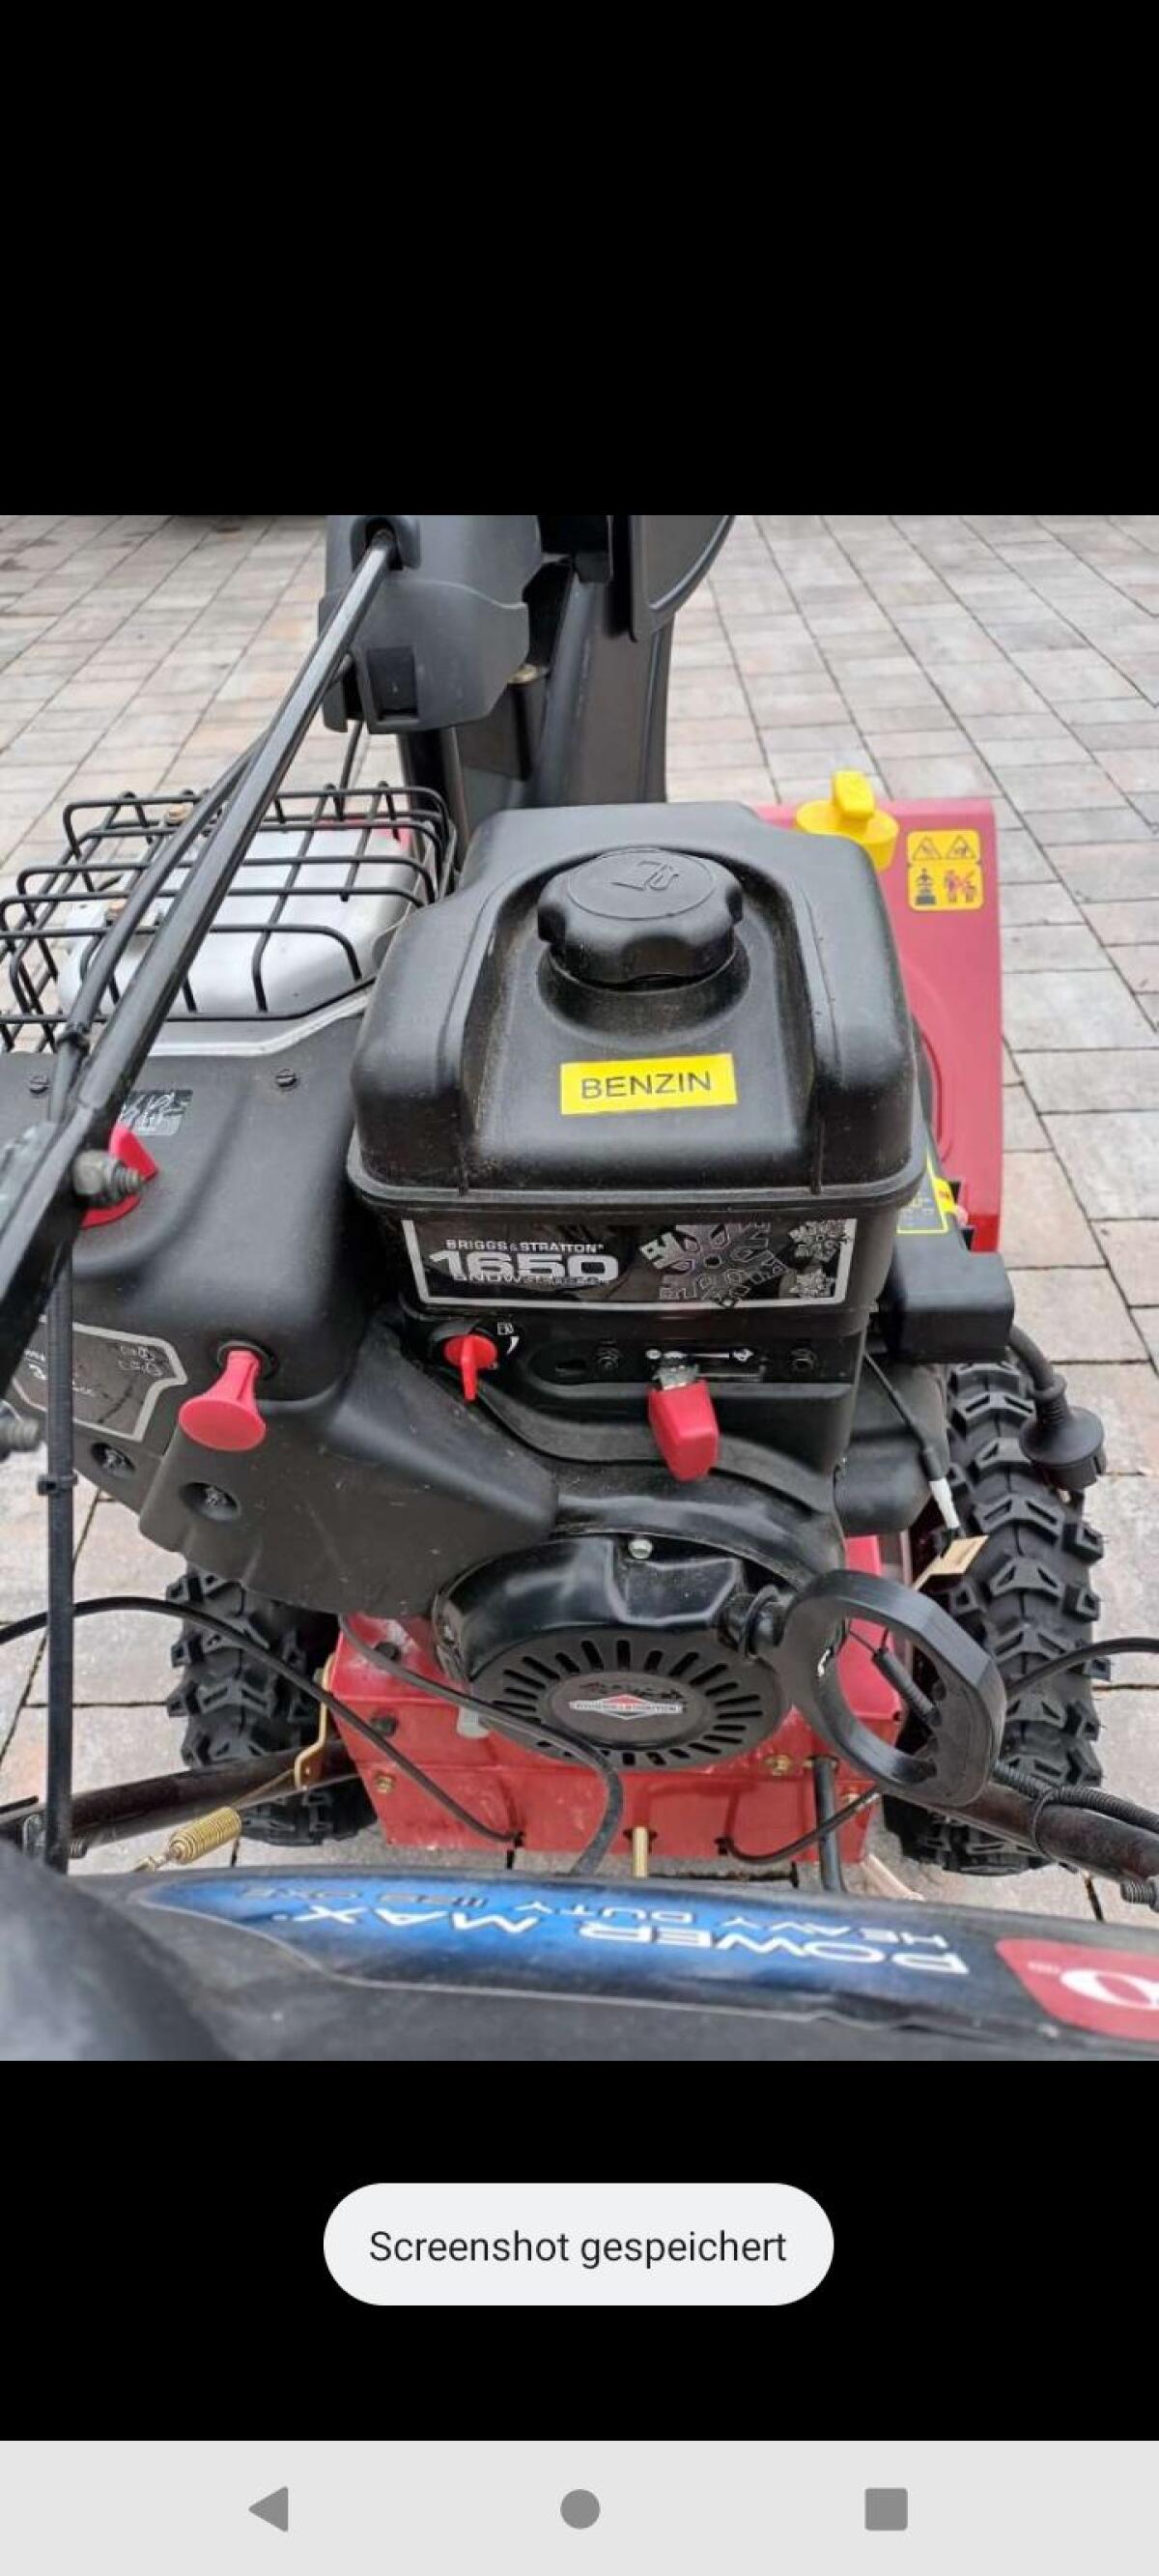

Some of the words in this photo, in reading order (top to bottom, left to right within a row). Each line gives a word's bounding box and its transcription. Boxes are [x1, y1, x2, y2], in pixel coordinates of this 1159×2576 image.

[581, 1071, 711, 1100] BENZIN
[430, 1249, 619, 1282] 1650
[292, 1905, 538, 1933] MAX
[514, 1901, 694, 1925] DUTY
[722, 1916, 948, 1948] HEAVY
[579, 1920, 969, 1975] POWER
